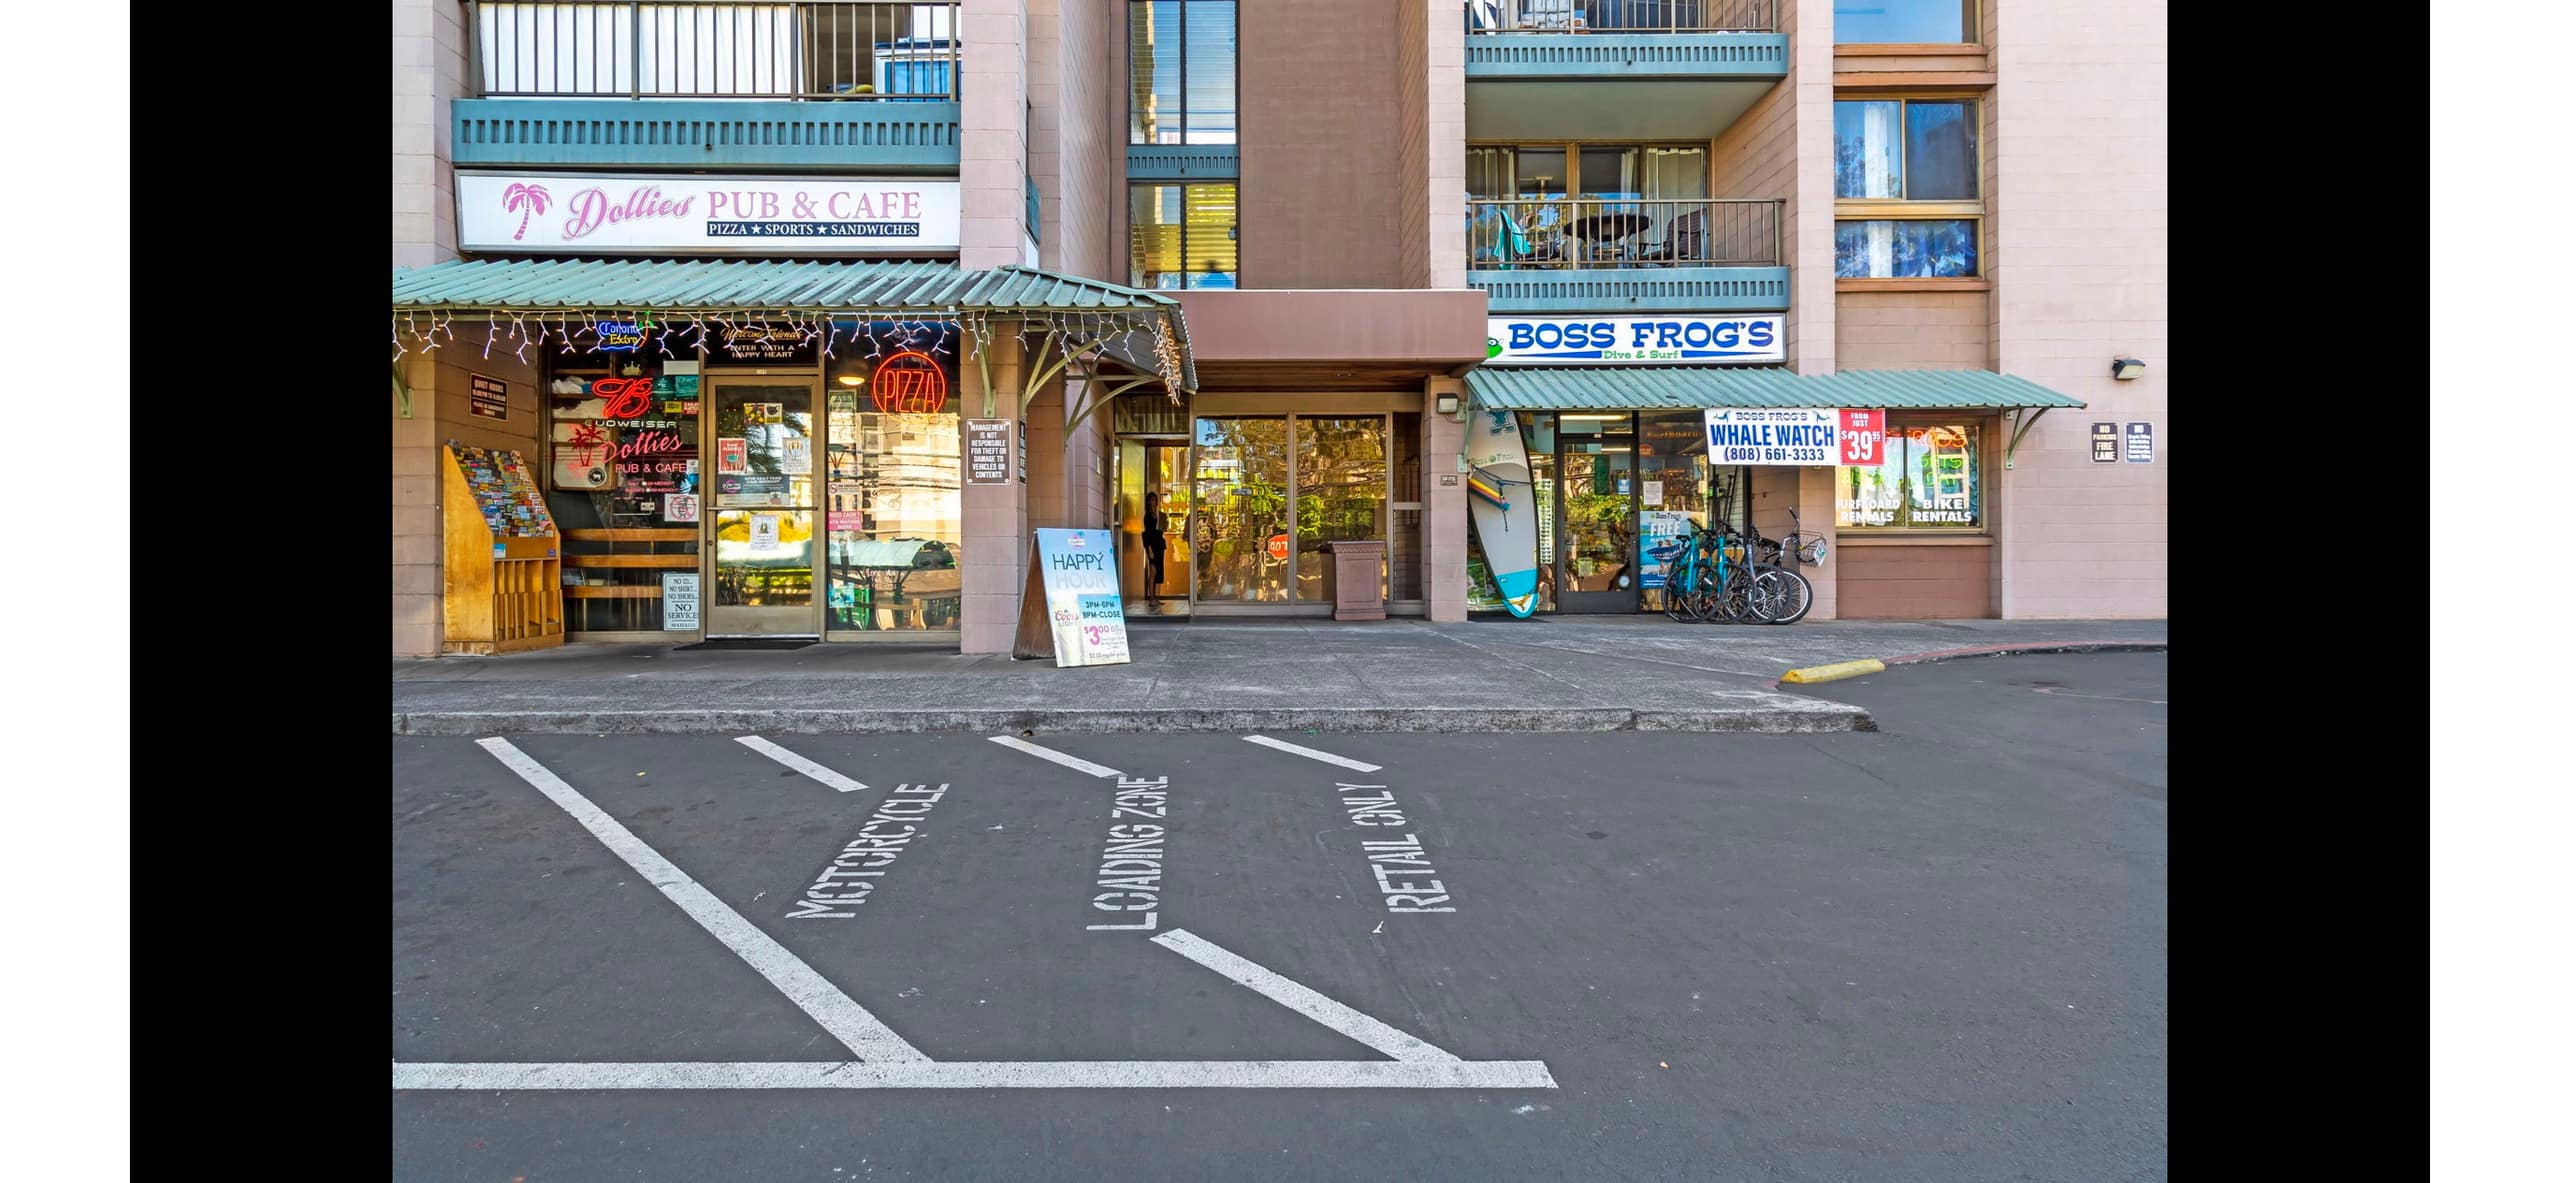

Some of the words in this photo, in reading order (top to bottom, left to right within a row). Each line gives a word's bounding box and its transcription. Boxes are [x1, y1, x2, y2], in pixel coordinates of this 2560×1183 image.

[561, 186, 696, 240] Dollies
[707, 191, 780, 219] PUB
[792, 191, 818, 219] &
[828, 191, 922, 219] CAFE
[709, 224, 747, 235] PIZZA
[765, 223, 813, 236] SPORTS
[831, 224, 918, 236] SANDWICHES
[599, 322, 641, 335] Corona
[1508, 323, 1615, 349] BOSS
[1631, 321, 1774, 349] FROG'S
[610, 334, 638, 345] Extra
[1603, 350, 1631, 359] Dive
[1635, 350, 1646, 359] &
[1649, 350, 1680, 359] Surf
[883, 370, 937, 413] PIZZA
[1736, 412, 1766, 421] BOSS
[1768, 412, 1808, 421] FROG'S
[1710, 424, 1772, 446] WHALE
[1775, 425, 1835, 446] WATCH
[599, 431, 683, 464] Dollies
[2096, 442, 2114, 450] FIRE
[1724, 447, 1761, 461] (808)
[1765, 448, 1825, 460] 661-3333
[2095, 451, 2116, 460] LANE
[615, 463, 639, 473] PUB
[643, 463, 651, 473] &
[655, 463, 687, 473] CAFE
[1922, 499, 1963, 510] BIKE
[1912, 511, 1972, 522] RENTALS
[1650, 522, 1680, 536] FREE
[1052, 552, 1104, 570] HAPPY
[1056, 573, 1106, 589] HOUR
[1112, 776, 1168, 818] ZONE
[1336, 782, 1406, 826] ONLY
[785, 783, 951, 919] MOTORCYCLE
[1086, 824, 1165, 930] LOADING
[1362, 834, 1456, 912] RETAIL
